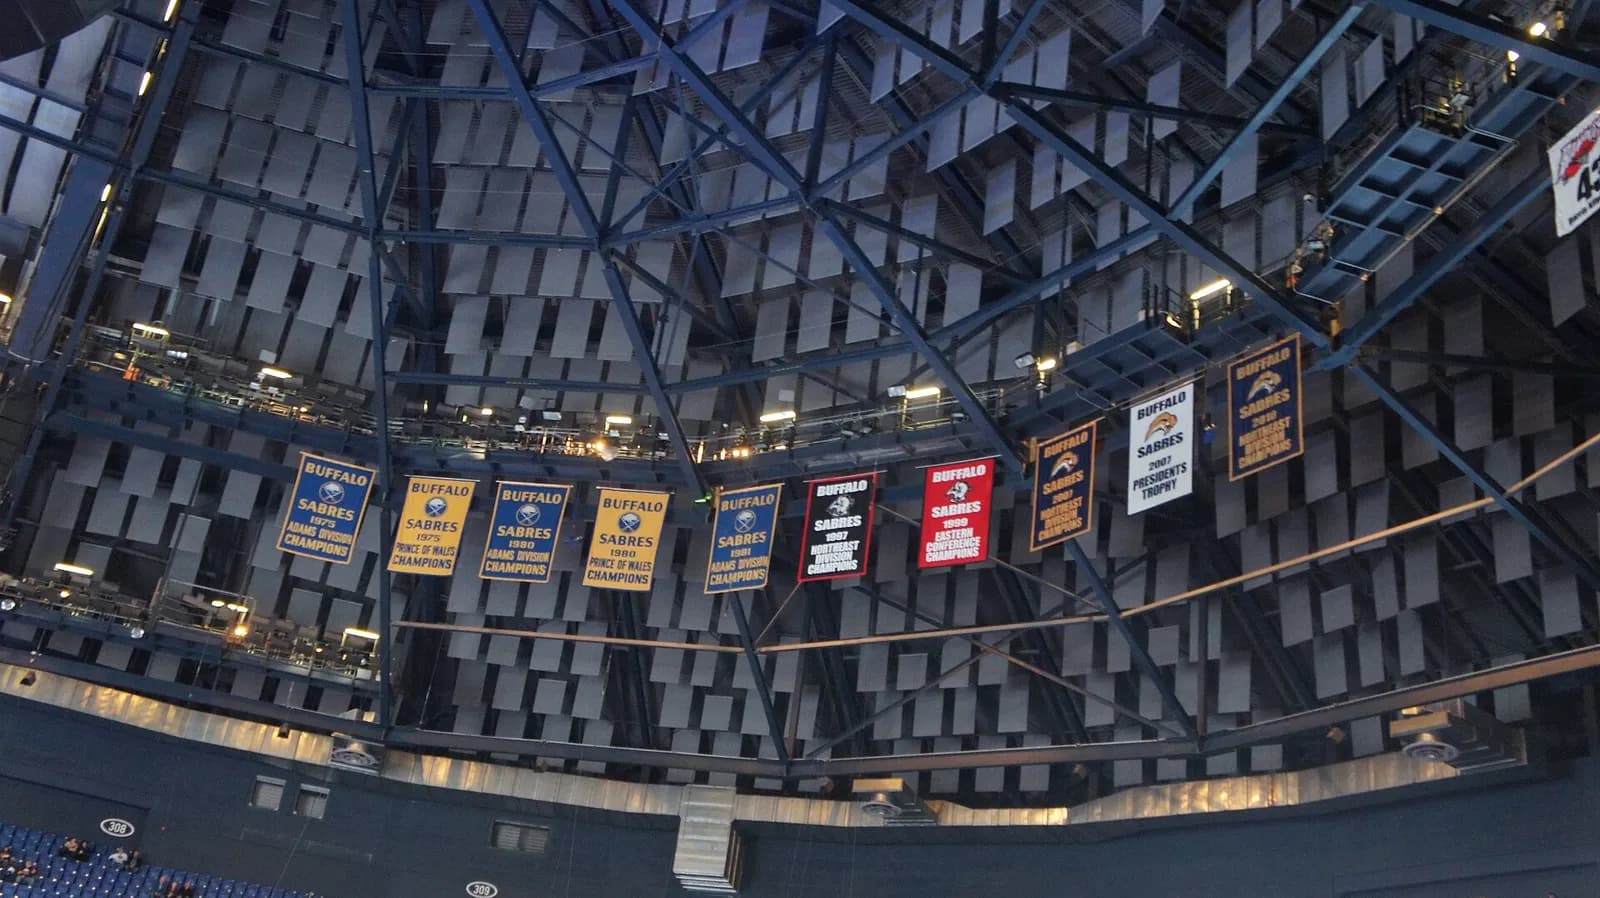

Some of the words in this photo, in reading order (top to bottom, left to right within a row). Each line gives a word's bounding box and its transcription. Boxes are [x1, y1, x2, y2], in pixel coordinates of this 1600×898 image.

[1236, 347, 1291, 380] BUFFALO
[1137, 391, 1187, 421] BUFFALO
[1239, 388, 1291, 420] SABRES
[1239, 416, 1291, 448] NORTHEAST
[1044, 431, 1089, 458] BUFFALO
[1137, 432, 1184, 459] SABRES
[1148, 455, 1172, 472] 2007
[304, 462, 368, 487] BUFFALO
[932, 464, 987, 483] BUFFALO
[1133, 462, 1187, 492] PRESIDENTS
[411, 482, 469, 497] BUFFALO
[816, 480, 868, 497] BUFFALO
[1042, 470, 1084, 495] SABRES
[1142, 478, 1177, 500] TROPHY
[502, 489, 562, 505] BUFFALO
[603, 497, 663, 513] BUFFALO
[720, 493, 775, 512] BUFFALO
[298, 498, 355, 521] SABRES
[931, 500, 982, 519] SABRES
[1040, 496, 1083, 521] NORTHEAST
[310, 515, 336, 528] 1975
[405, 518, 458, 533] SABRES
[814, 515, 862, 532] SABRES
[943, 517, 968, 529] 1999
[1044, 508, 1079, 529] DIVISION
[286, 521, 316, 537] ADAMS
[318, 528, 353, 545] DIVISION
[416, 533, 441, 542] 1975
[496, 525, 552, 540] SABRES
[825, 531, 849, 542] 1997
[934, 527, 974, 542] EASTERN
[1038, 517, 1083, 541] CHAMPIONS
[284, 533, 349, 557] CHAMPIONS
[508, 540, 535, 550] 1980
[599, 533, 654, 548] SABRES
[718, 531, 767, 548] SABRES
[811, 540, 860, 556] NORTHEAST
[926, 536, 980, 553] CONFERENCE
[396, 542, 420, 555] PRINCE
[421, 545, 432, 555] OF
[432, 545, 456, 556] WALES
[487, 548, 515, 560] ADAMS
[517, 550, 550, 563] DIVISION
[610, 548, 636, 558] 1980
[730, 548, 751, 558] 1981
[926, 546, 979, 563] CHAMPIONS
[392, 554, 452, 569] CHAMPIONS
[589, 557, 615, 570] PRINCE
[616, 559, 628, 570] OF
[628, 560, 652, 572] WALES
[711, 560, 737, 573] ADAMS
[738, 555, 769, 570] DIVISION
[815, 551, 854, 565] DIVISION
[485, 561, 547, 576] CHAMPIONS
[710, 568, 767, 585] CHAMPIONS
[807, 560, 859, 576] CHAMPIONS
[587, 570, 649, 585] CHAMPIONS
[108, 821, 127, 834] 308
[473, 884, 490, 896] 309
